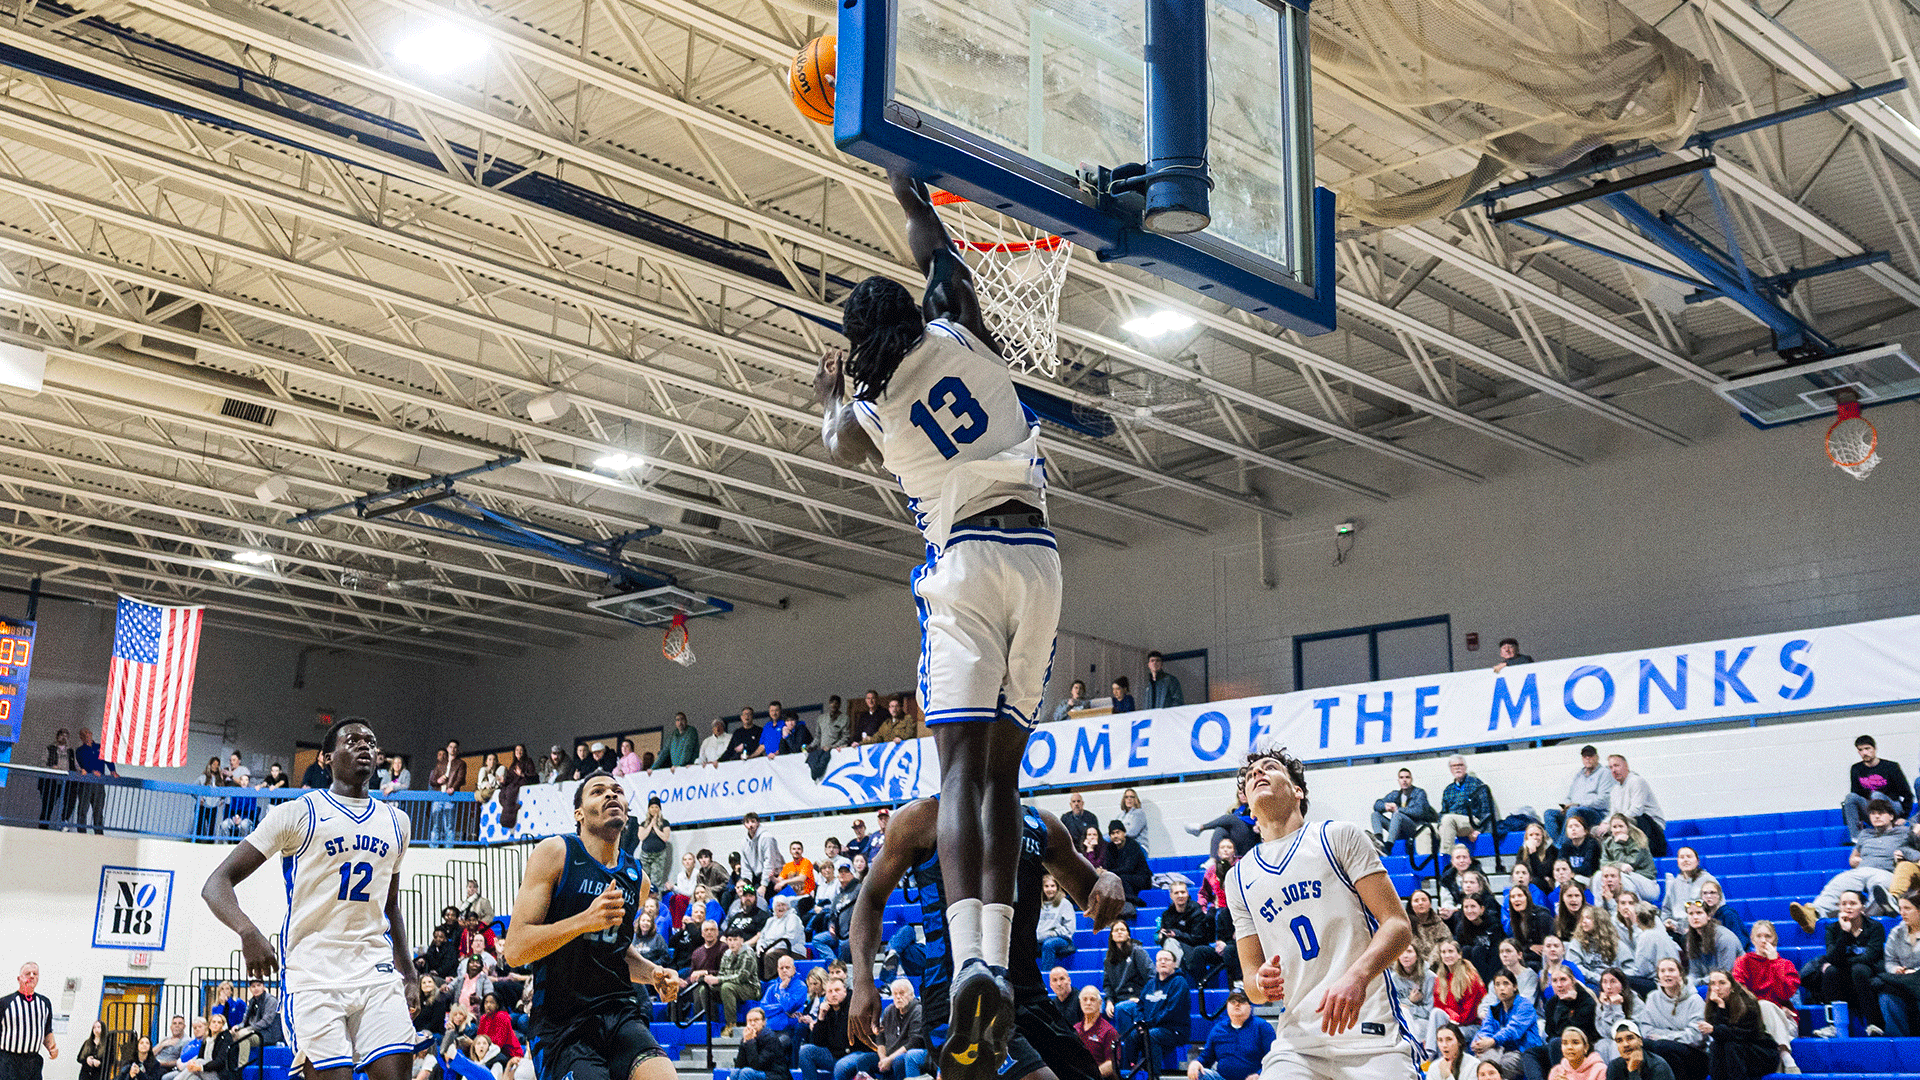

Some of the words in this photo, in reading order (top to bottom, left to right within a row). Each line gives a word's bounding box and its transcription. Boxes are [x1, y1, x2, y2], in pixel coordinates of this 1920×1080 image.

[909, 376, 989, 460] 13
[1021, 719, 1152, 778] OME
[1190, 705, 1273, 762] OF
[1313, 685, 1440, 749] THE
[1488, 639, 1815, 731] MONKS
[324, 836, 349, 856] ST.
[352, 834, 390, 858] JOE'S
[115, 881, 157, 909] NO
[337, 861, 374, 902] 12
[1259, 897, 1283, 923] ST.
[1281, 880, 1322, 906] JOE'S
[111, 908, 153, 935] H8
[1289, 914, 1321, 961] 0
